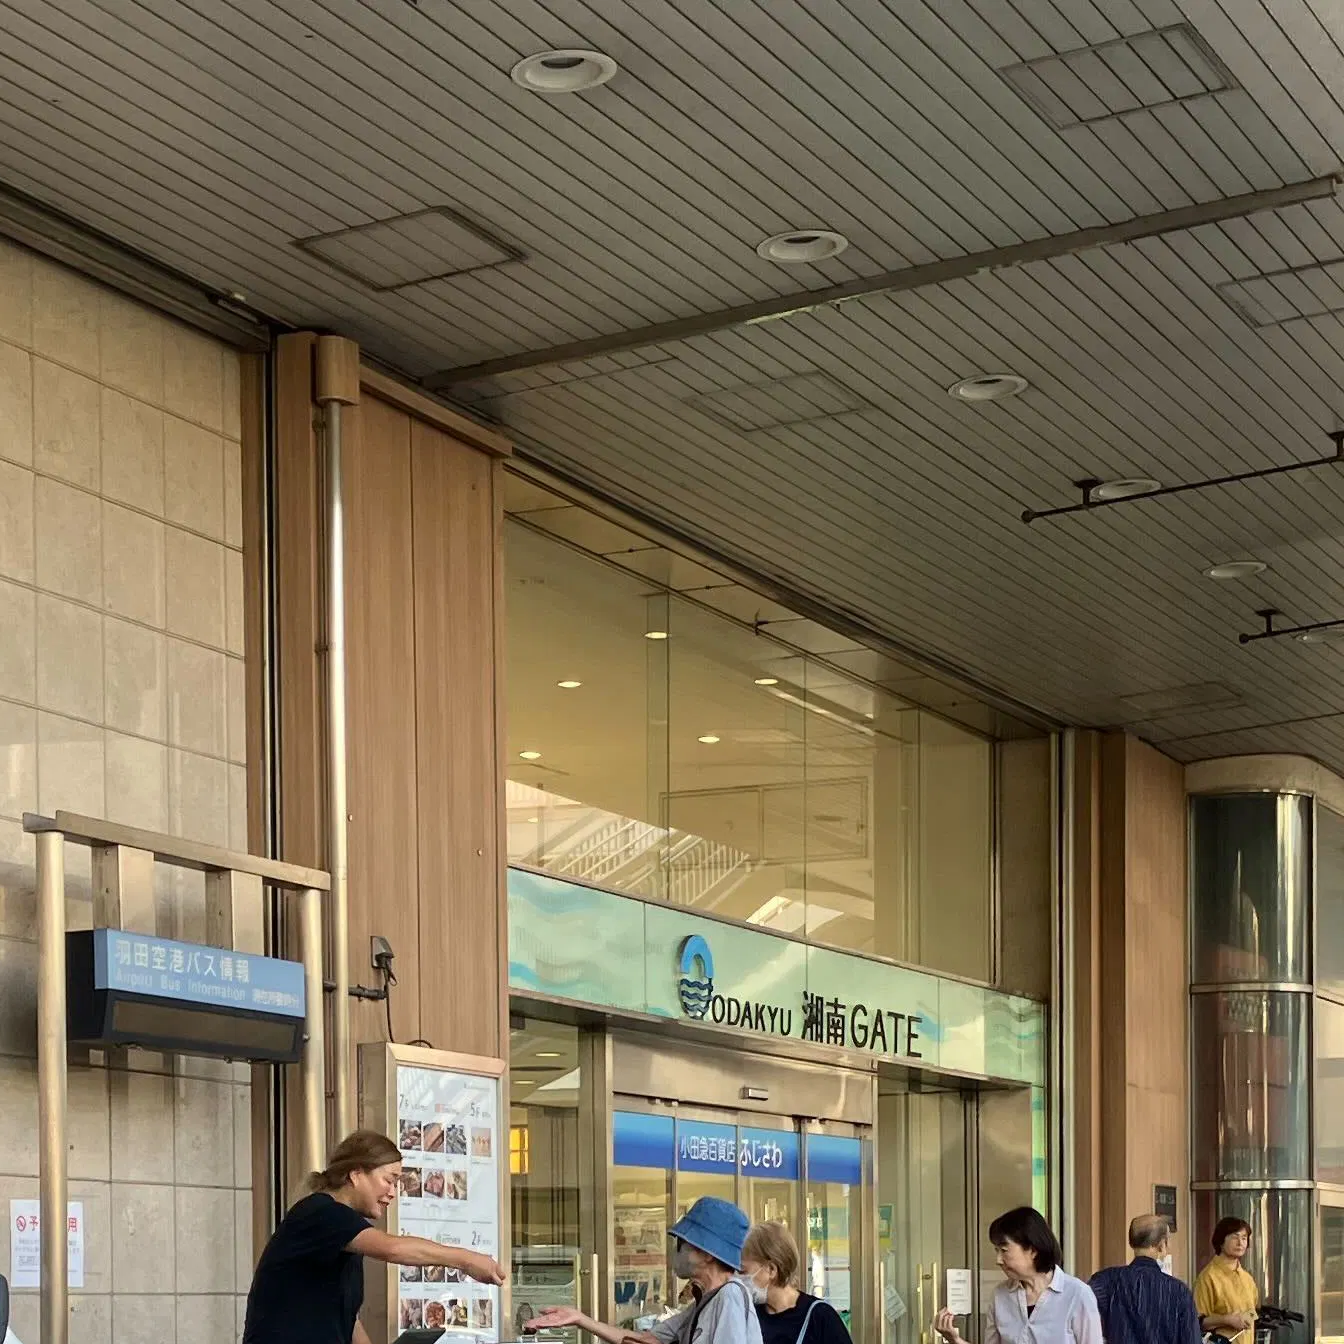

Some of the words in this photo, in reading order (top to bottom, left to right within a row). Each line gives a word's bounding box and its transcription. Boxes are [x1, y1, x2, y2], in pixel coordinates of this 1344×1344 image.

[114, 938, 250, 983] 羽田空港バス情報
[160, 974, 182, 993] Bus
[187, 978, 246, 1001] Information
[711, 994, 793, 1037] ODAKYU
[680, 1135, 736, 1163] 小田急百貨店
[739, 1138, 783, 1169] ふじさわ
